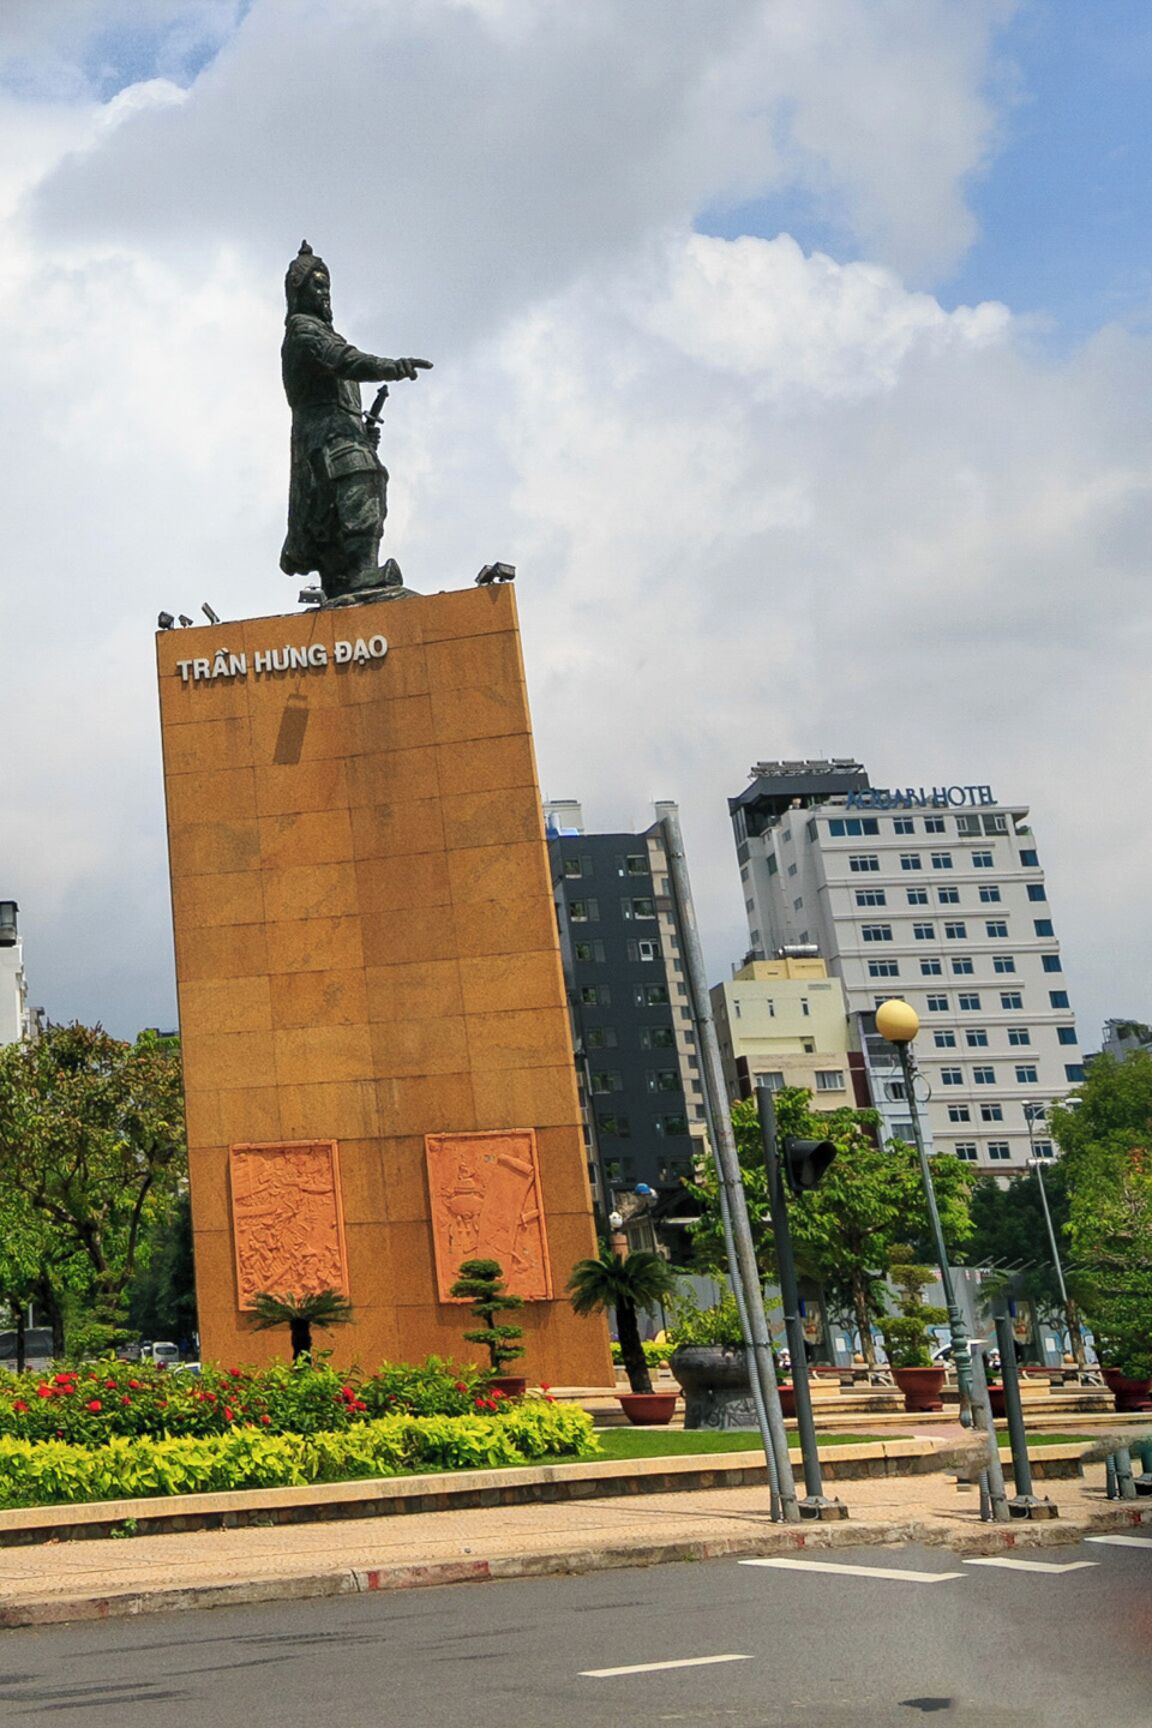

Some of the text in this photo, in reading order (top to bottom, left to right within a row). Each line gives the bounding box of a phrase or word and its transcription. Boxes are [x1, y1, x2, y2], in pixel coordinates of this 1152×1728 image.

[176, 634, 389, 682] TRẦN HƯNG ĐẠO
[932, 785, 998, 809] HOTEL
